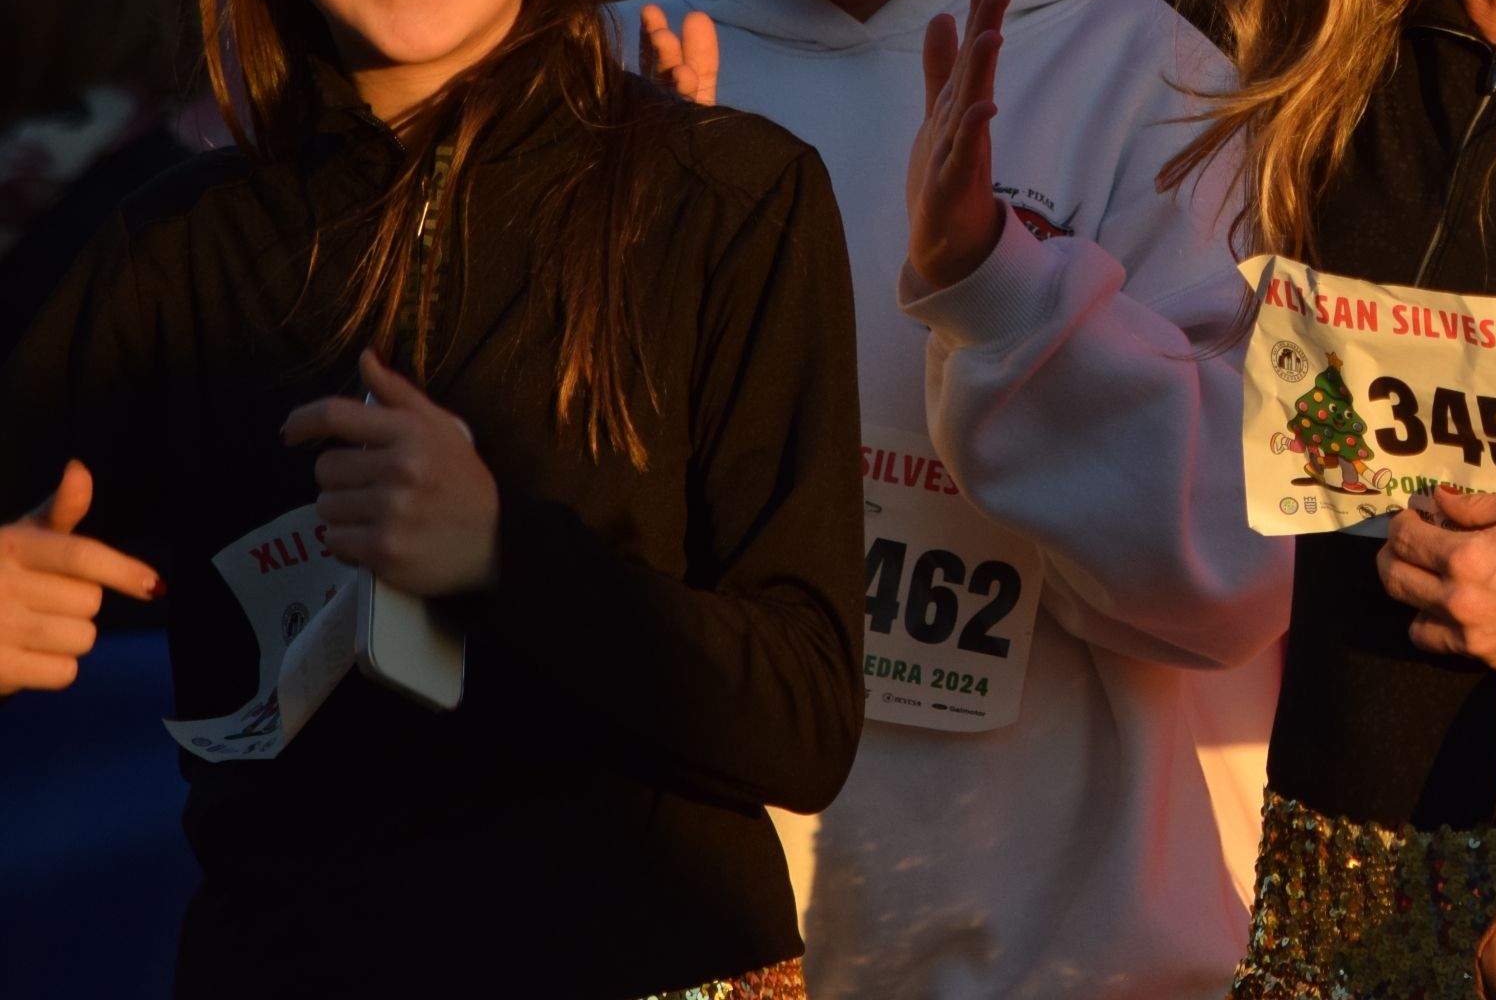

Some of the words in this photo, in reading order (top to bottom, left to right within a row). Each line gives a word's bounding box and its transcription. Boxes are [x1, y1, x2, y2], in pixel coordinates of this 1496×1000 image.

[1265, 278, 1307, 316] XLI
[1315, 293, 1378, 332] SAN
[249, 531, 310, 575] XLI
[930, 668, 989, 697] 2024
